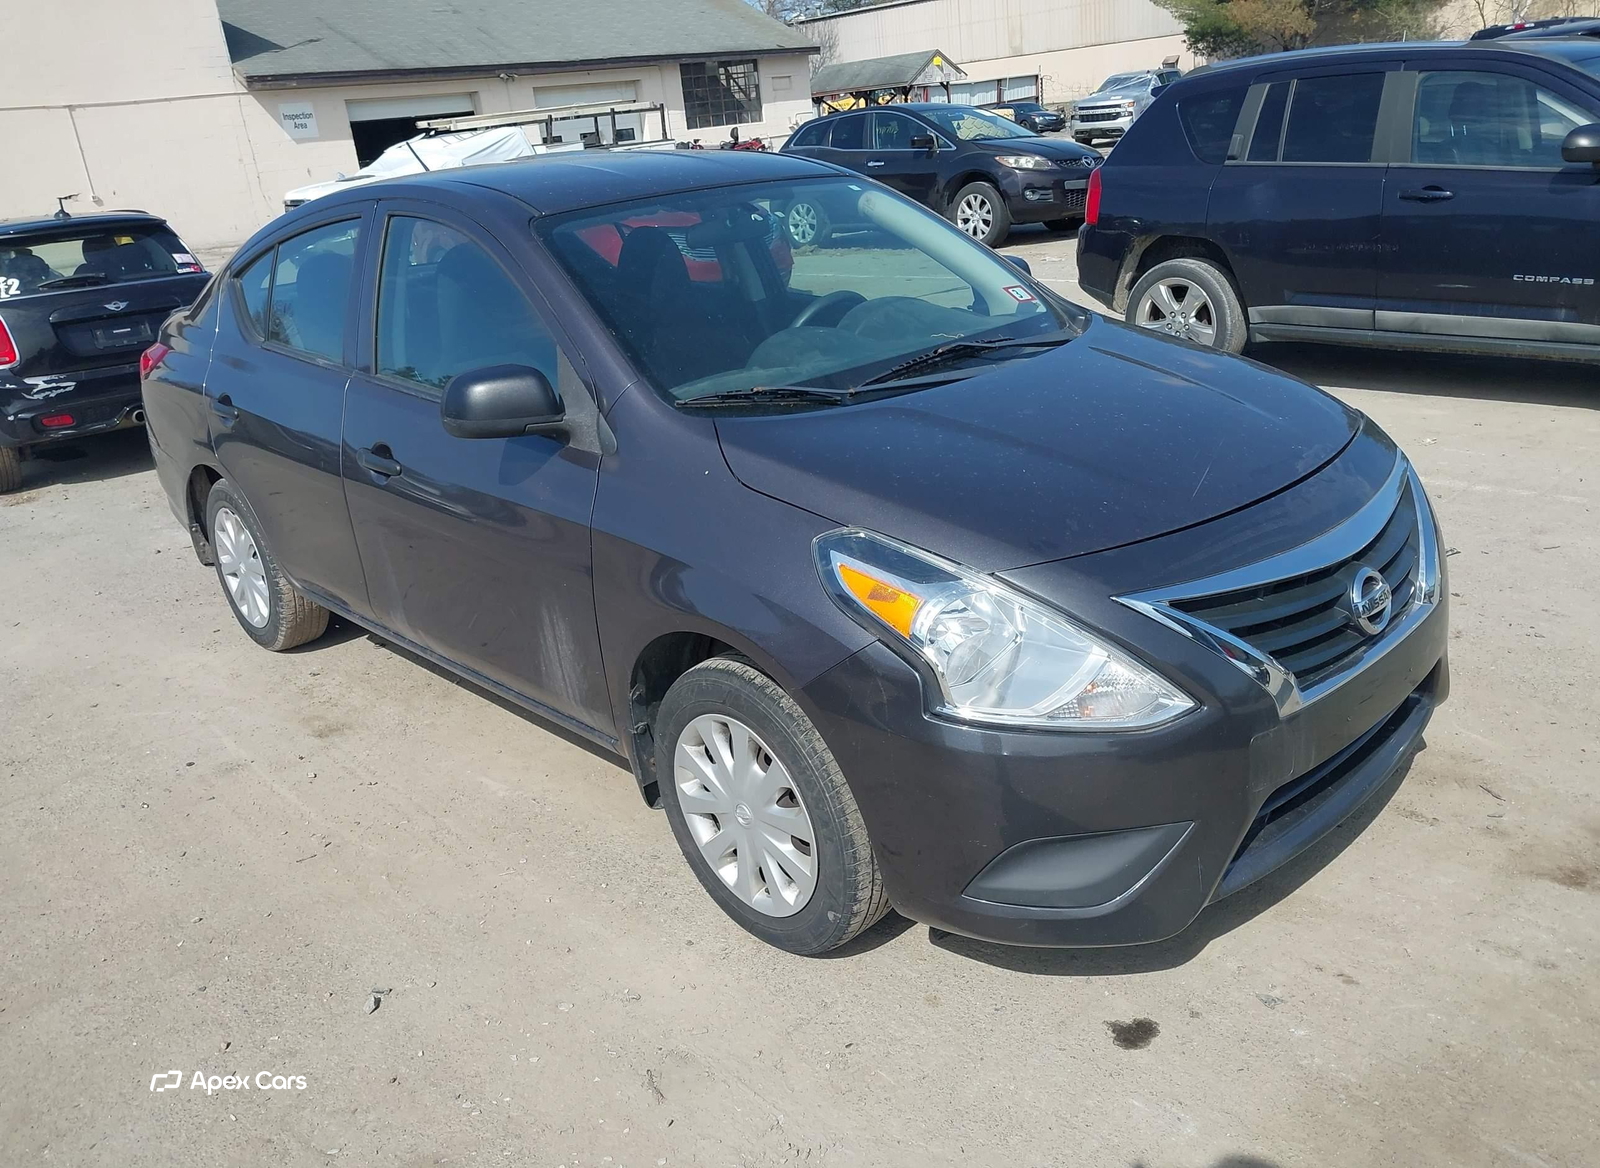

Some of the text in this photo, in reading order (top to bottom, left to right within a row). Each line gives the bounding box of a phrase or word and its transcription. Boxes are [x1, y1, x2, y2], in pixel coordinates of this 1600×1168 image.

[282, 112, 314, 121] Inspection
[294, 121, 308, 129] Area
[1513, 274, 1595, 285] COMPASS
